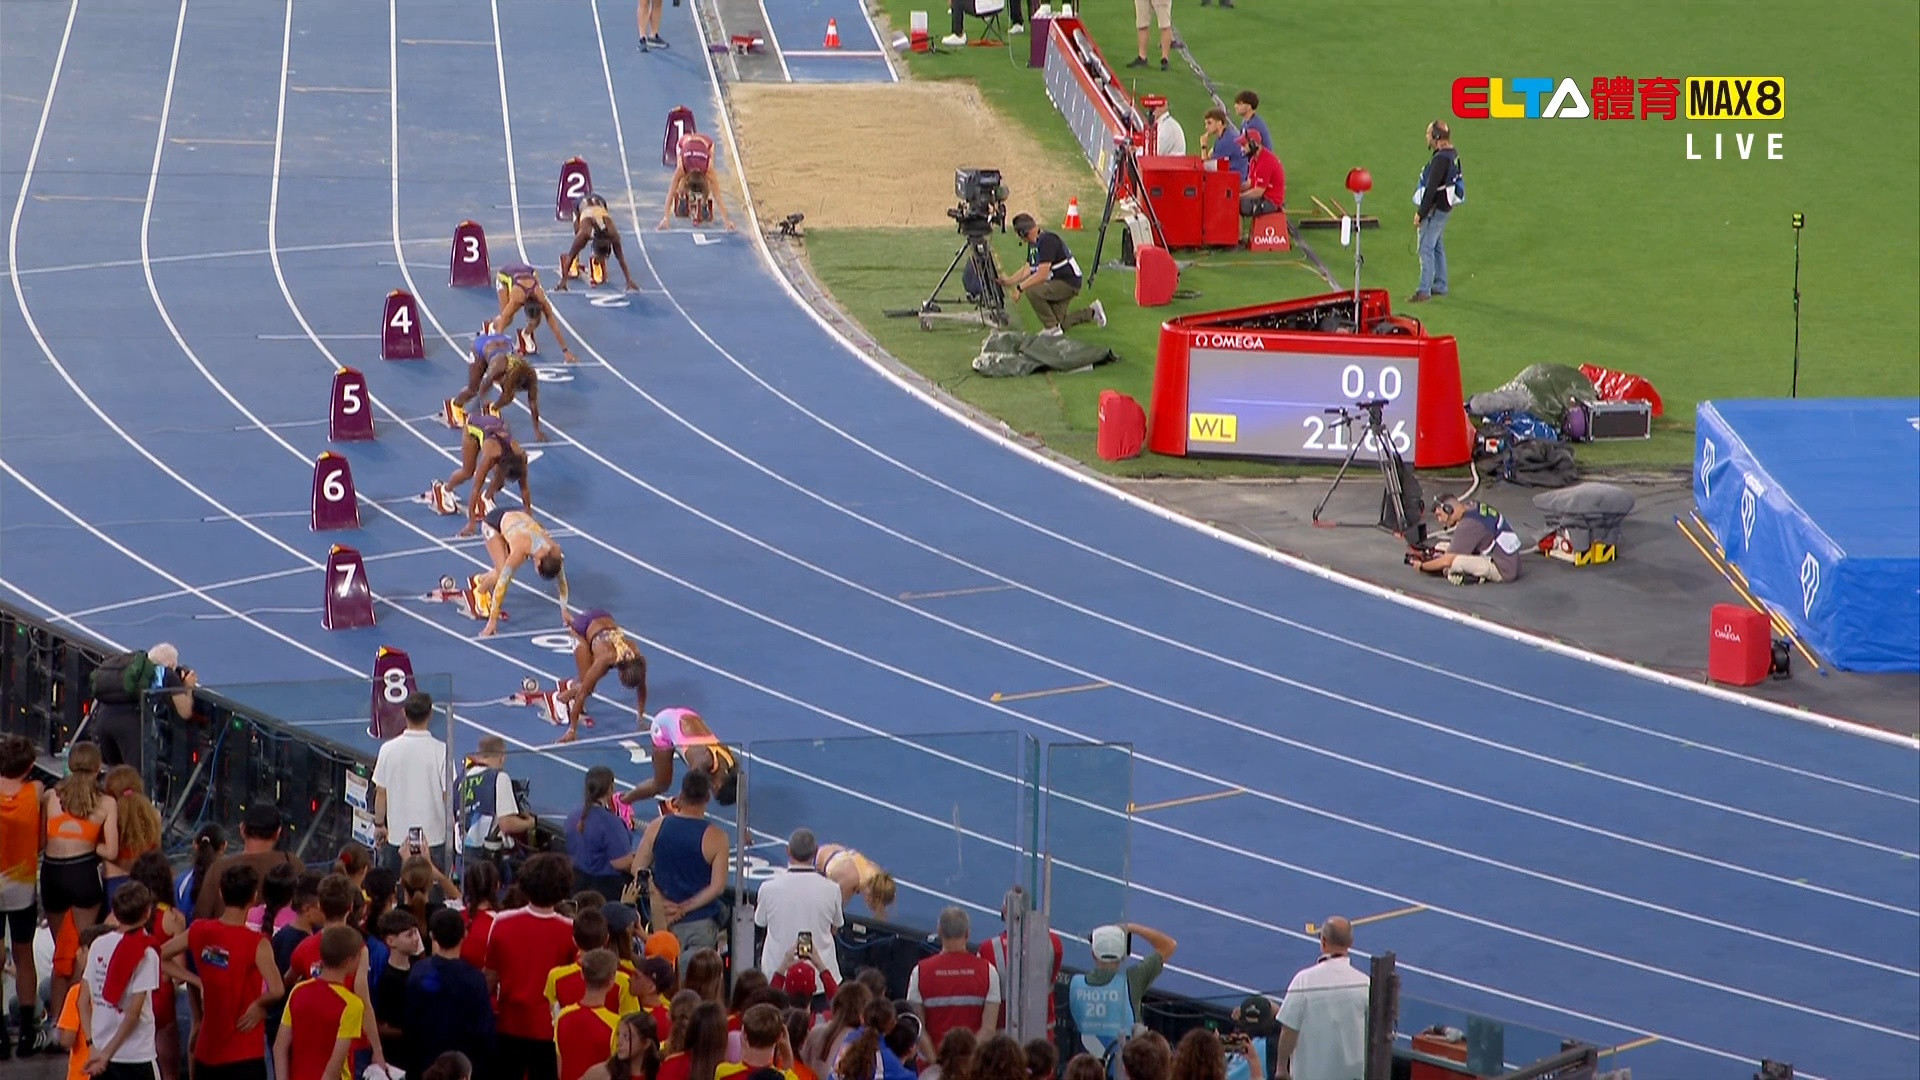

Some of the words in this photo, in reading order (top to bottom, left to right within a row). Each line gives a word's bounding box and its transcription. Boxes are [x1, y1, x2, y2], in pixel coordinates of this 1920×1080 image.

[673, 120, 684, 139] 1
[567, 173, 586, 198] 2
[462, 236, 480, 263] 3
[1254, 235, 1287, 245] OMEGA
[390, 305, 412, 334] 4
[1211, 333, 1265, 350] OMEGA
[1341, 364, 1402, 400] 0.0
[343, 384, 361, 415] 5
[1195, 417, 1231, 439] WL
[323, 469, 345, 501] 6
[335, 563, 356, 597] 7
[1714, 629, 1742, 643] OMEGA
[383, 668, 409, 703] 8
[1076, 988, 1119, 1003] PHOTO
[1086, 1003, 1107, 1018] 20
